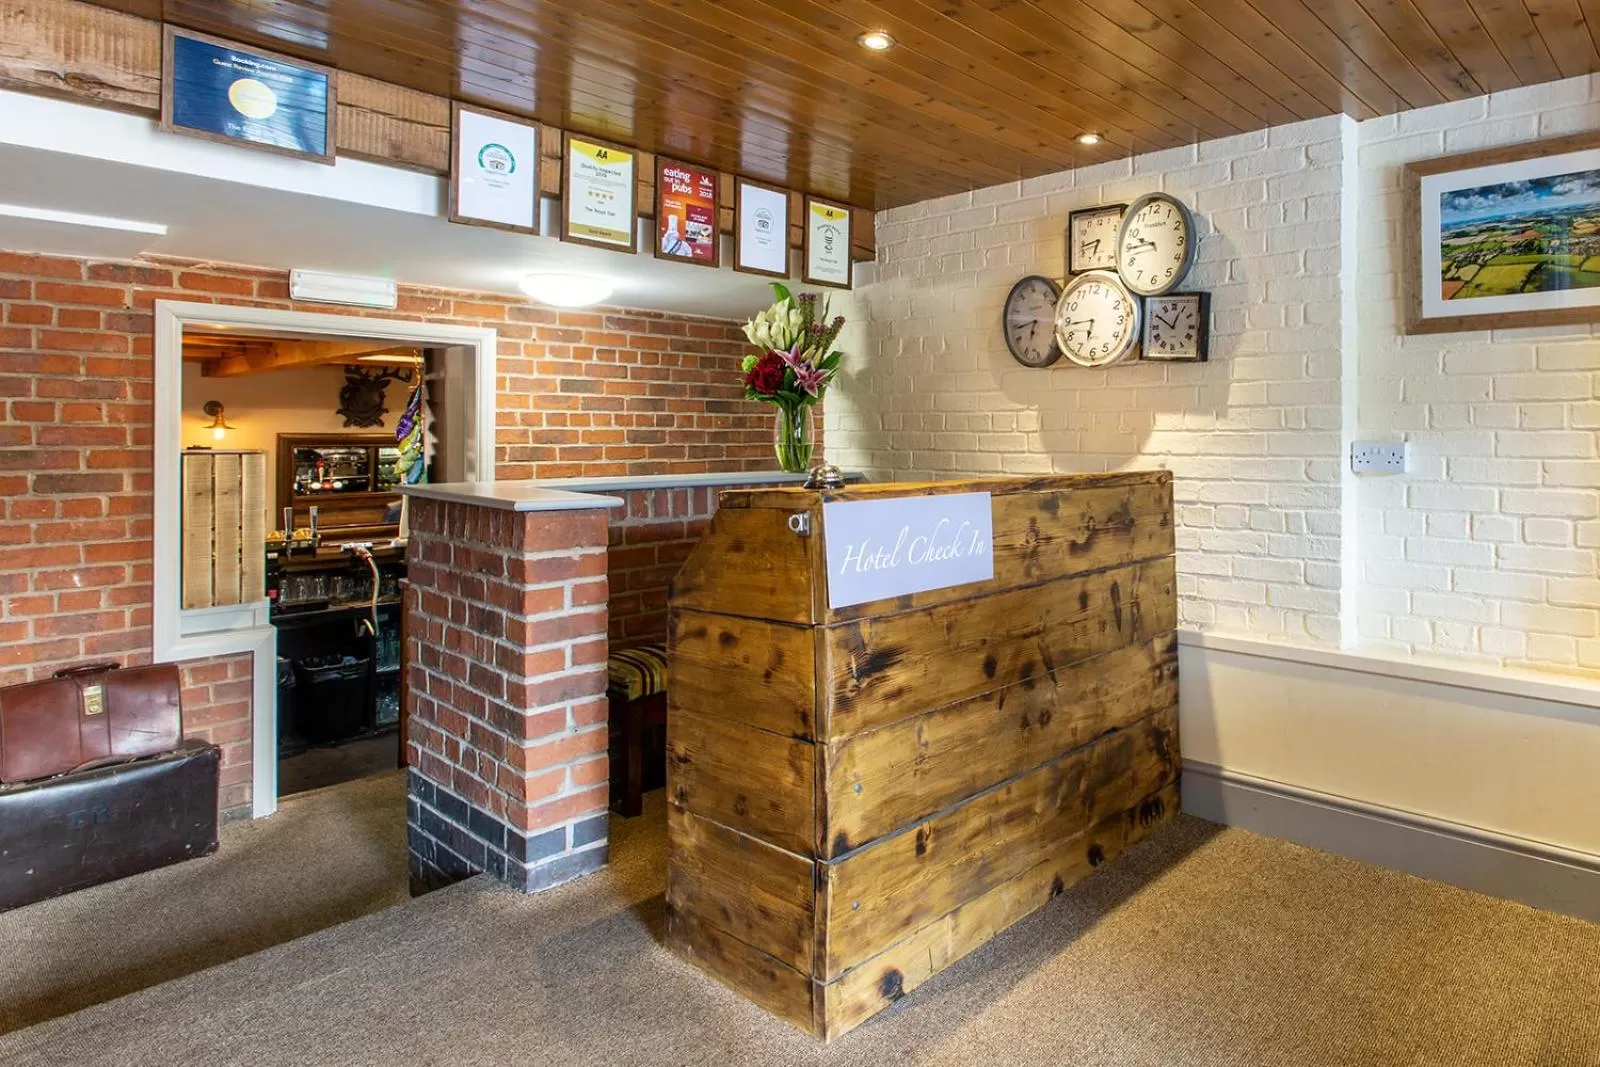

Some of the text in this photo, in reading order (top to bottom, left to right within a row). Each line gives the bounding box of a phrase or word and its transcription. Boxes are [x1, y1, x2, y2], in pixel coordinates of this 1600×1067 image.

[231, 56, 277, 71] Booking.com
[596, 150, 608, 160] AA
[664, 168, 691, 183] eating
[672, 182, 692, 194] pubs
[1149, 205, 1160, 214] 12
[1167, 209, 1171, 218] 1
[1137, 213, 1146, 224] 11
[1174, 221, 1180, 230] 2
[1128, 229, 1139, 238] 10
[1176, 236, 1184, 246] 3
[1128, 257, 1135, 267] 8
[1174, 254, 1181, 263] 4
[1137, 271, 1142, 280] 7
[1165, 268, 1172, 277] 5
[1151, 276, 1157, 284] 6
[1078, 290, 1086, 299] 11
[1089, 285, 1100, 294] 12
[1105, 289, 1109, 299] 1
[1066, 302, 1078, 311] 10
[1113, 300, 1120, 310] 2
[1065, 317, 1071, 327] 9
[1116, 315, 1124, 325] 3
[1067, 331, 1074, 341] 8
[1112, 332, 1119, 340] 4
[1077, 342, 1083, 352] 7
[1089, 348, 1096, 356] 6
[1102, 342, 1109, 352] 5
[840, 518, 986, 575] Hotel Check In
